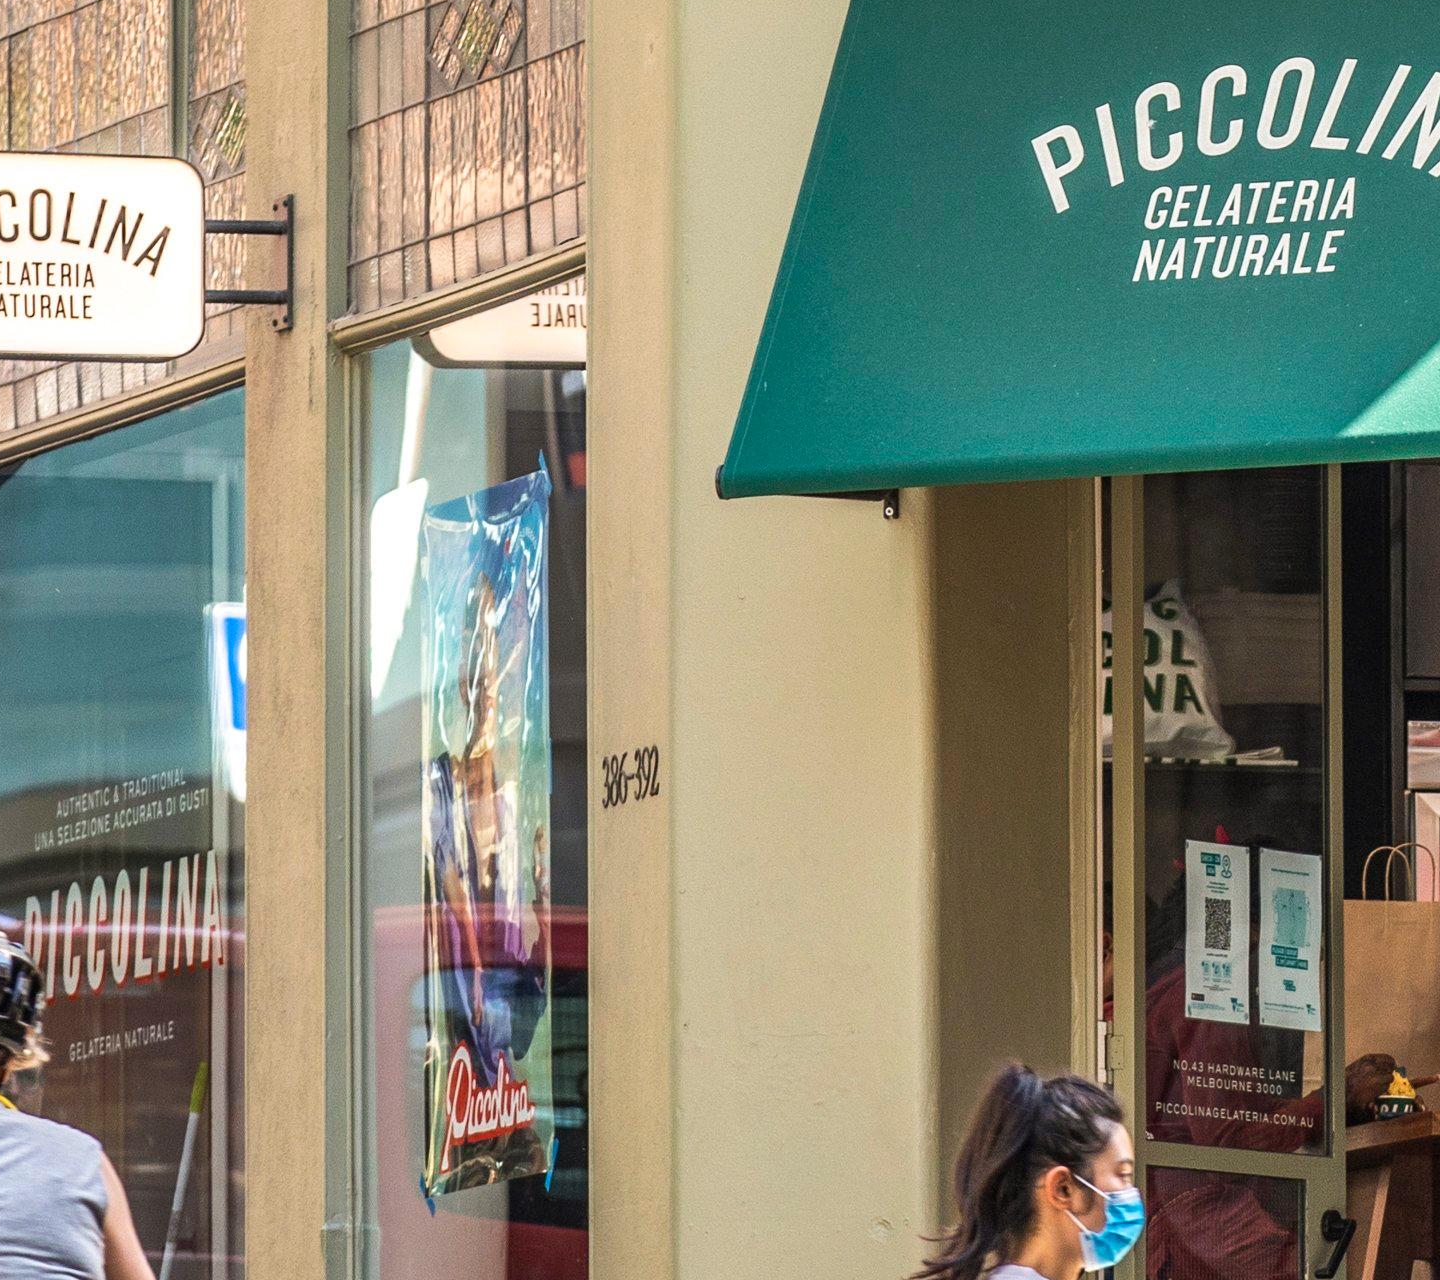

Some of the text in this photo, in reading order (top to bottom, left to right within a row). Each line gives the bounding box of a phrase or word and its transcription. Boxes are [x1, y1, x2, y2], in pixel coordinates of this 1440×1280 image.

[1143, 176, 1359, 231] GELATERIA
[1131, 229, 1346, 284] NATURALE
[56, 768, 187, 820] AUTHENTIC & TRADITIONAL
[601, 744, 660, 810] 386-392
[34, 787, 210, 852] UNA SELEZIONE ACCURATA DI GUSTI
[23, 848, 225, 1007] PICCOLINA
[68, 1020, 175, 1062] GELATERIA NATURALE
[1172, 1059, 1297, 1083] NO.43 HARDWARE LANE
[1186, 1075, 1284, 1096] MELBOURNE 3000
[440, 1043, 535, 1172] Piccolina
[1154, 1101, 1315, 1129] PICCOLINAGELATERIA.COM.AU
